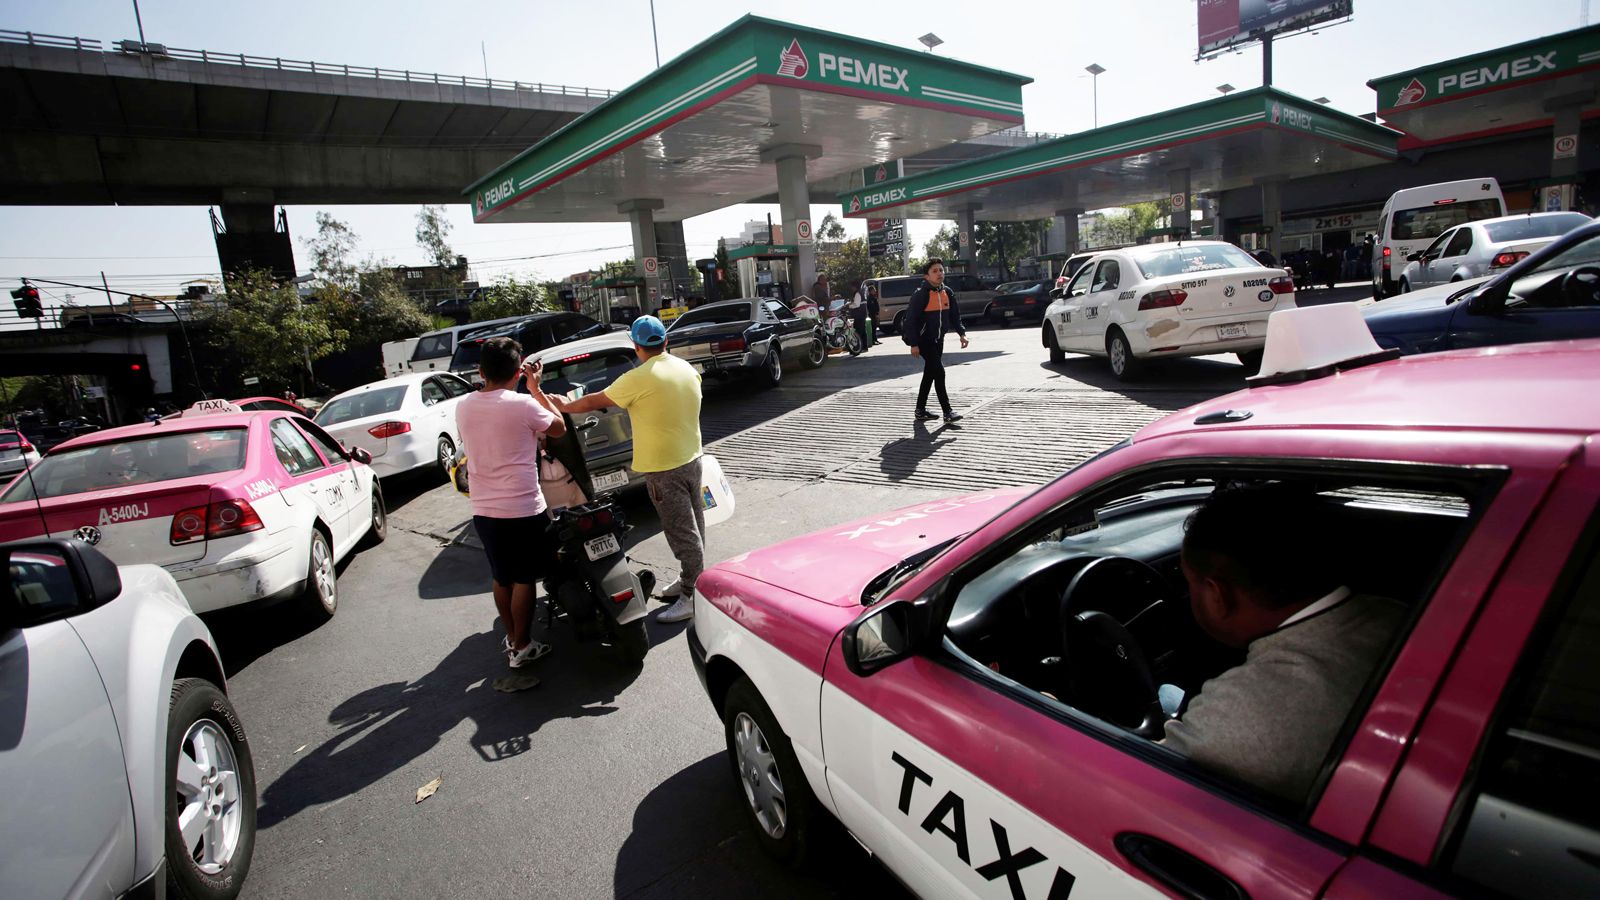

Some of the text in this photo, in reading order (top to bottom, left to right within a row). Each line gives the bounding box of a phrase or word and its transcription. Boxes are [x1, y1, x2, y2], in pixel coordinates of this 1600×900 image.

[818, 52, 910, 92] PEMEX
[1438, 50, 1557, 94] PEMEX
[1283, 107, 1312, 130] PEMEX
[484, 177, 515, 208] PEMEX
[863, 187, 906, 207] PEMEX
[801, 225, 808, 233] 10
[1181, 279, 1208, 290] SITIO 517
[197, 400, 222, 411] TAXI
[98, 502, 149, 526] A-5400-J
[891, 750, 1076, 900] TAXI
